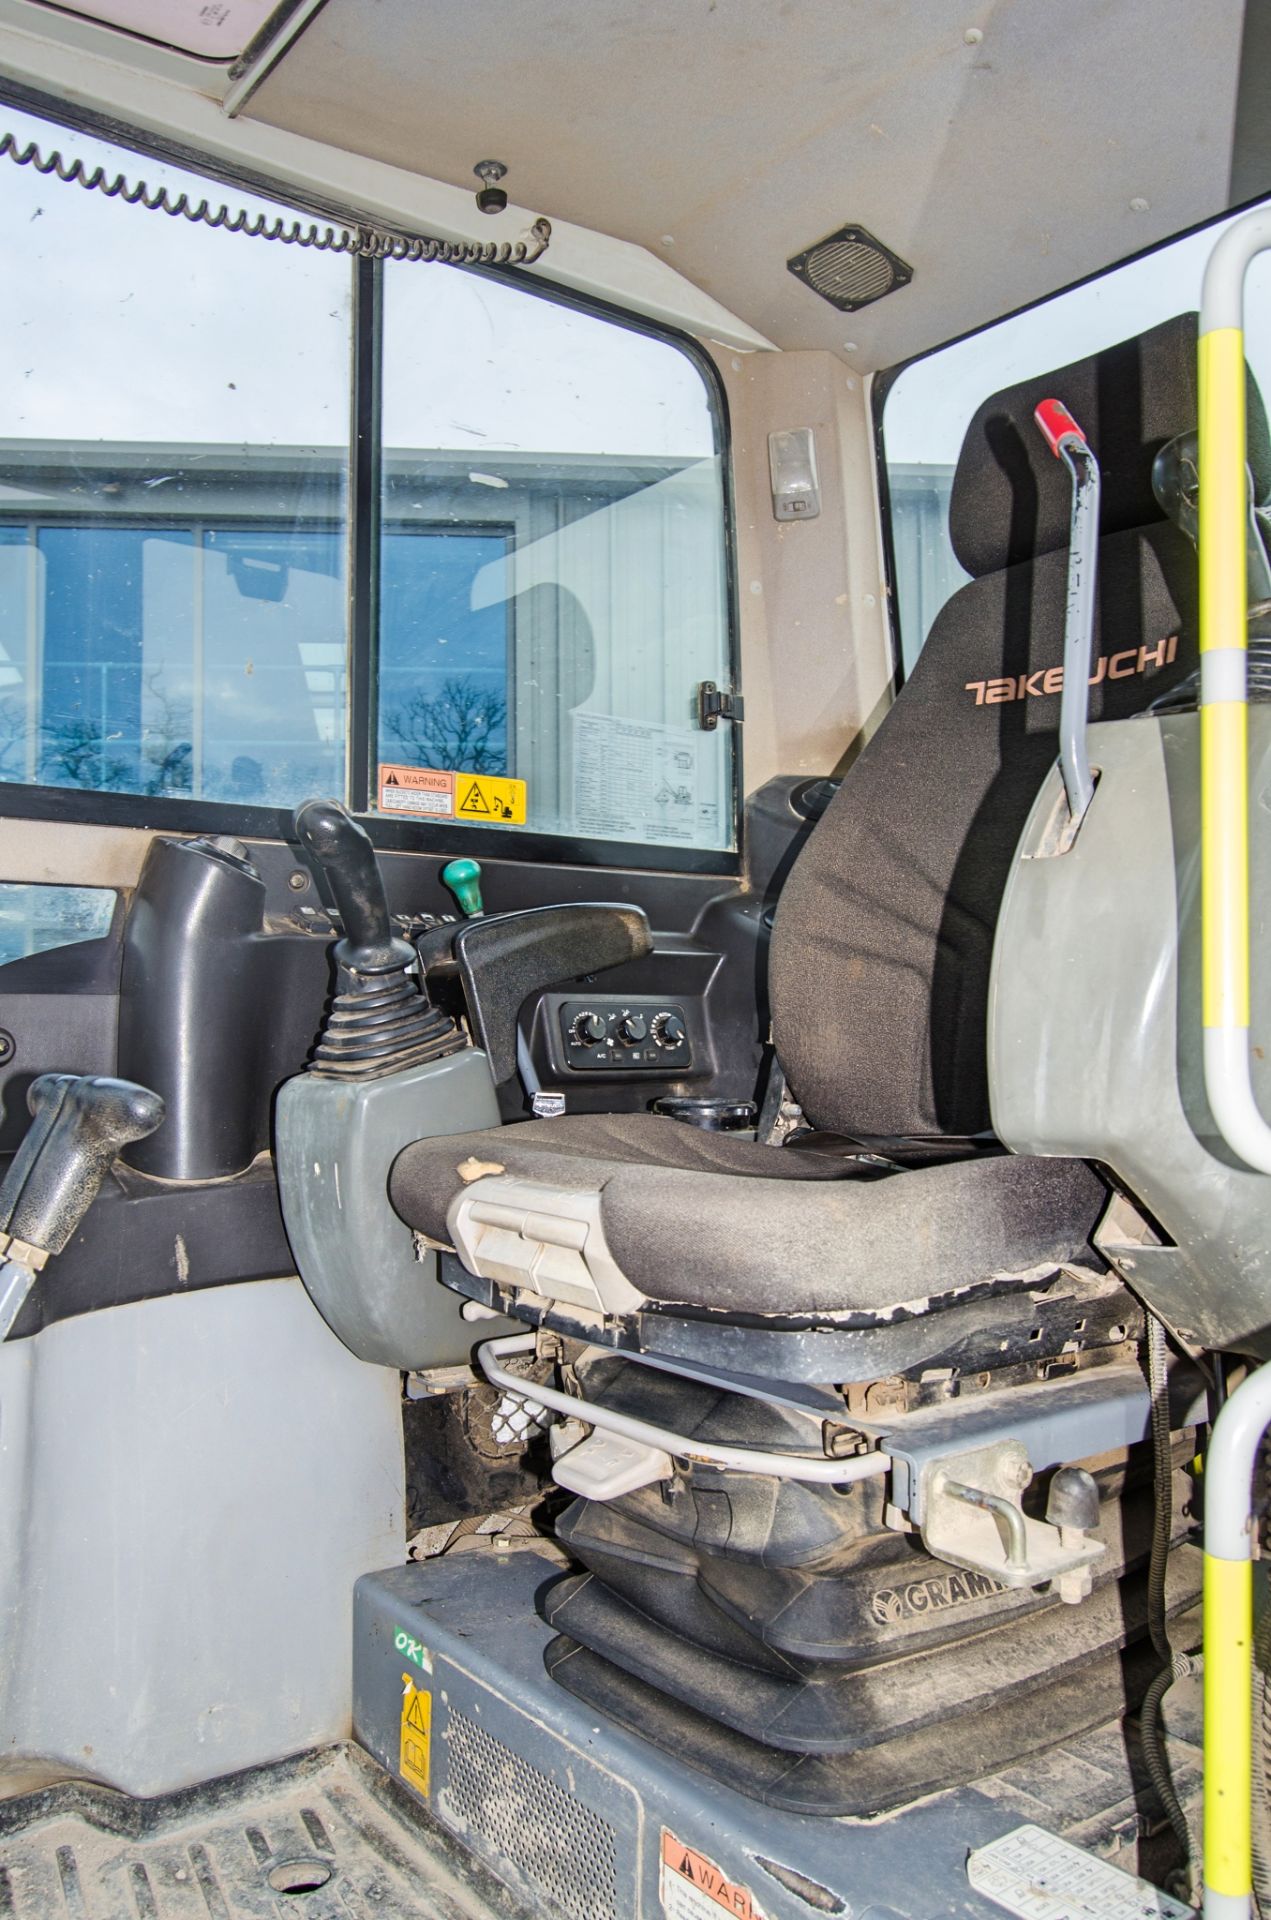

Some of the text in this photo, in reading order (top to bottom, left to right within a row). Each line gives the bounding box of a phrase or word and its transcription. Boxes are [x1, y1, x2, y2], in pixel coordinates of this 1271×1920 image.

[403, 775, 447, 788] WARNING
[905, 1571, 1008, 1613] GRAM
[395, 1632, 422, 1663] OK
